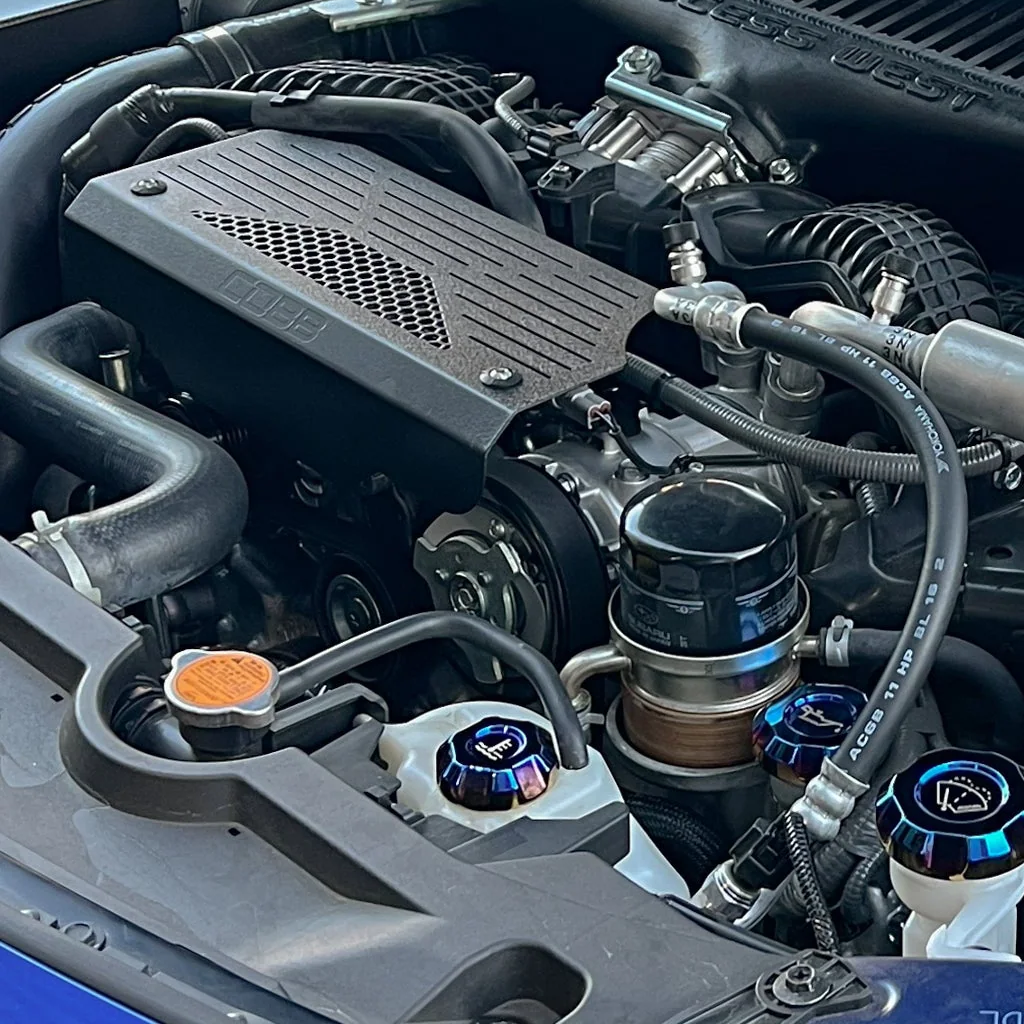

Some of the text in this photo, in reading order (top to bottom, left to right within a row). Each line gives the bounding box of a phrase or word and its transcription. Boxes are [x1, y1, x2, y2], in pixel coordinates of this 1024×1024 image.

[830, 45, 994, 113] WEST
[219, 268, 330, 344] COBB
[914, 404, 945, 458] YOKOHAMA
[884, 681, 900, 700] 11
[896, 648, 914, 676] HP
